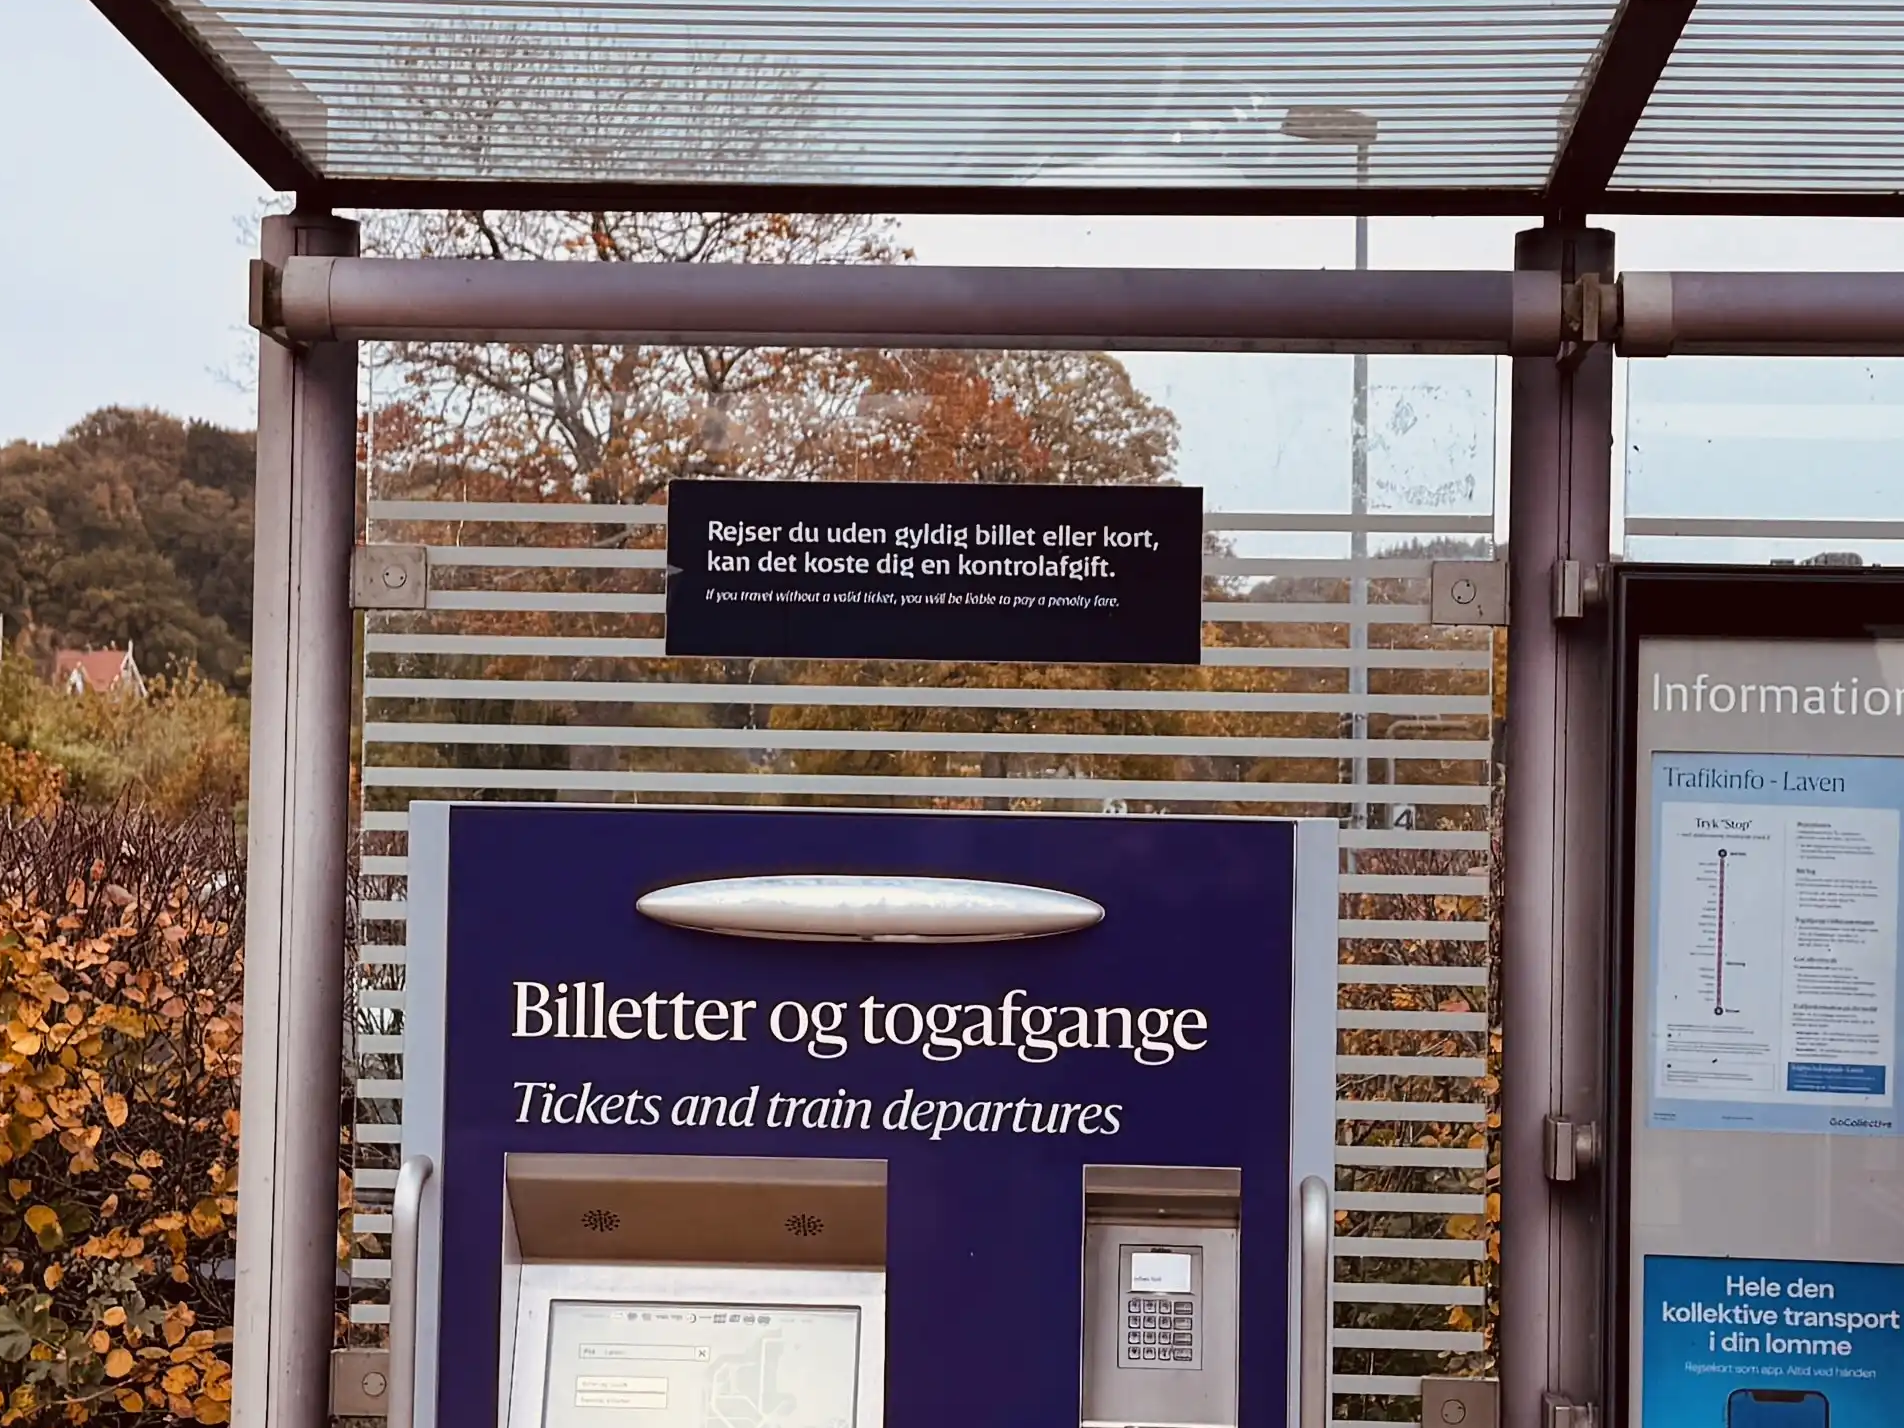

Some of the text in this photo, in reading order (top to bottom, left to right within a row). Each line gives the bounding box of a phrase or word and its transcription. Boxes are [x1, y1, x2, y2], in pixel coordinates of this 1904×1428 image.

[707, 521, 1159, 551] Rejser du uden gyldig billet eller kort,
[707, 551, 1115, 581] kan det koste dig en kontrolafgift.
[706, 588, 1119, 609] If you travel without a valid ticket, you will be liable to pay a penalty fare.
[1662, 766, 1764, 791] Trafikinfo
[1783, 771, 1846, 794] Laven
[1696, 818, 1719, 830] Tryk
[512, 980, 1209, 1064] Billetter og togafgange
[512, 1081, 1123, 1142] Tickets and train departures
[1726, 1276, 1834, 1300] Hele den
[1662, 1301, 1900, 1332] kollektive transport
[1709, 1331, 1852, 1357] i din lomme
[1685, 1361, 1732, 1374] Rejsekort
[1813, 1367, 1833, 1376] ved
